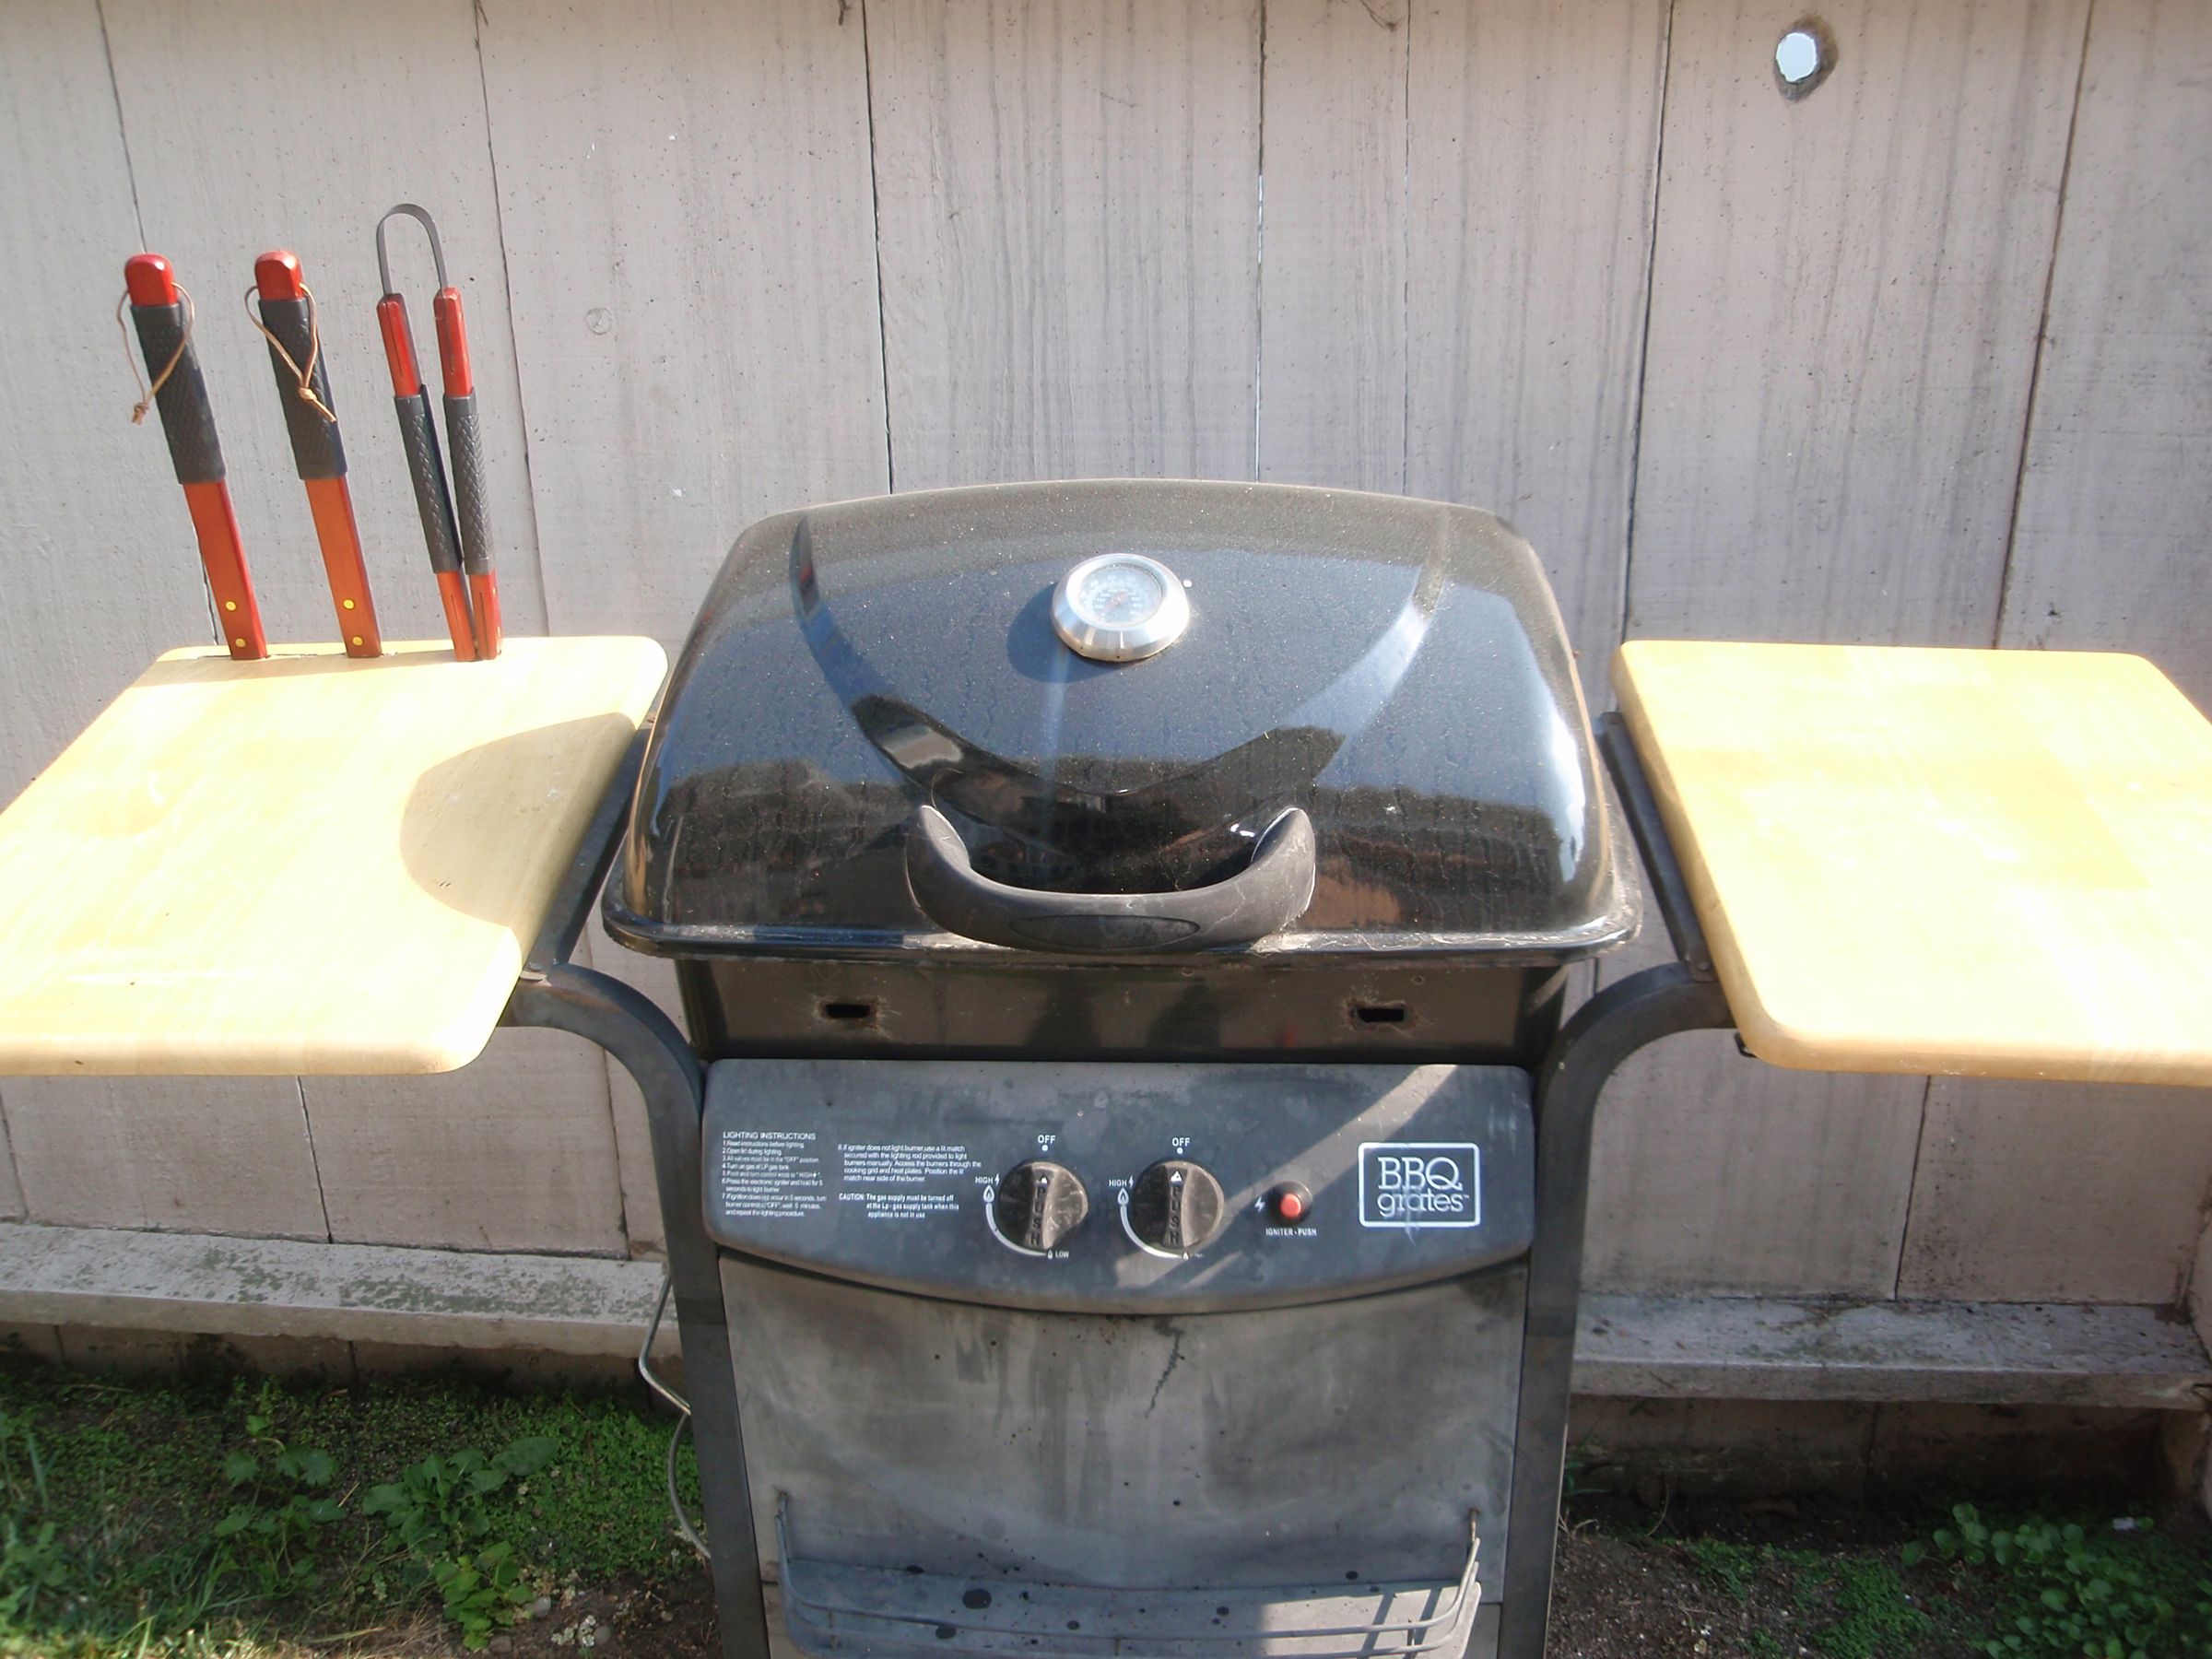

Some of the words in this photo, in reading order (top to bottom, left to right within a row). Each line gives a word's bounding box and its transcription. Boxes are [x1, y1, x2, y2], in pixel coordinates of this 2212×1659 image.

[723, 1132, 759, 1140] LIGHTING
[759, 1132, 817, 1141] INSTRUCTIONS
[1038, 1135, 1055, 1144] OFF
[1171, 1137, 1191, 1147] OFF
[1377, 1157, 1463, 1191] BBQ
[975, 1176, 994, 1184] HIGH
[1109, 1179, 1127, 1187] HIGH
[1029, 1184, 1045, 1246] PUSH
[1167, 1185, 1181, 1245] PUSH
[1298, 1227, 1317, 1236] PUSH
